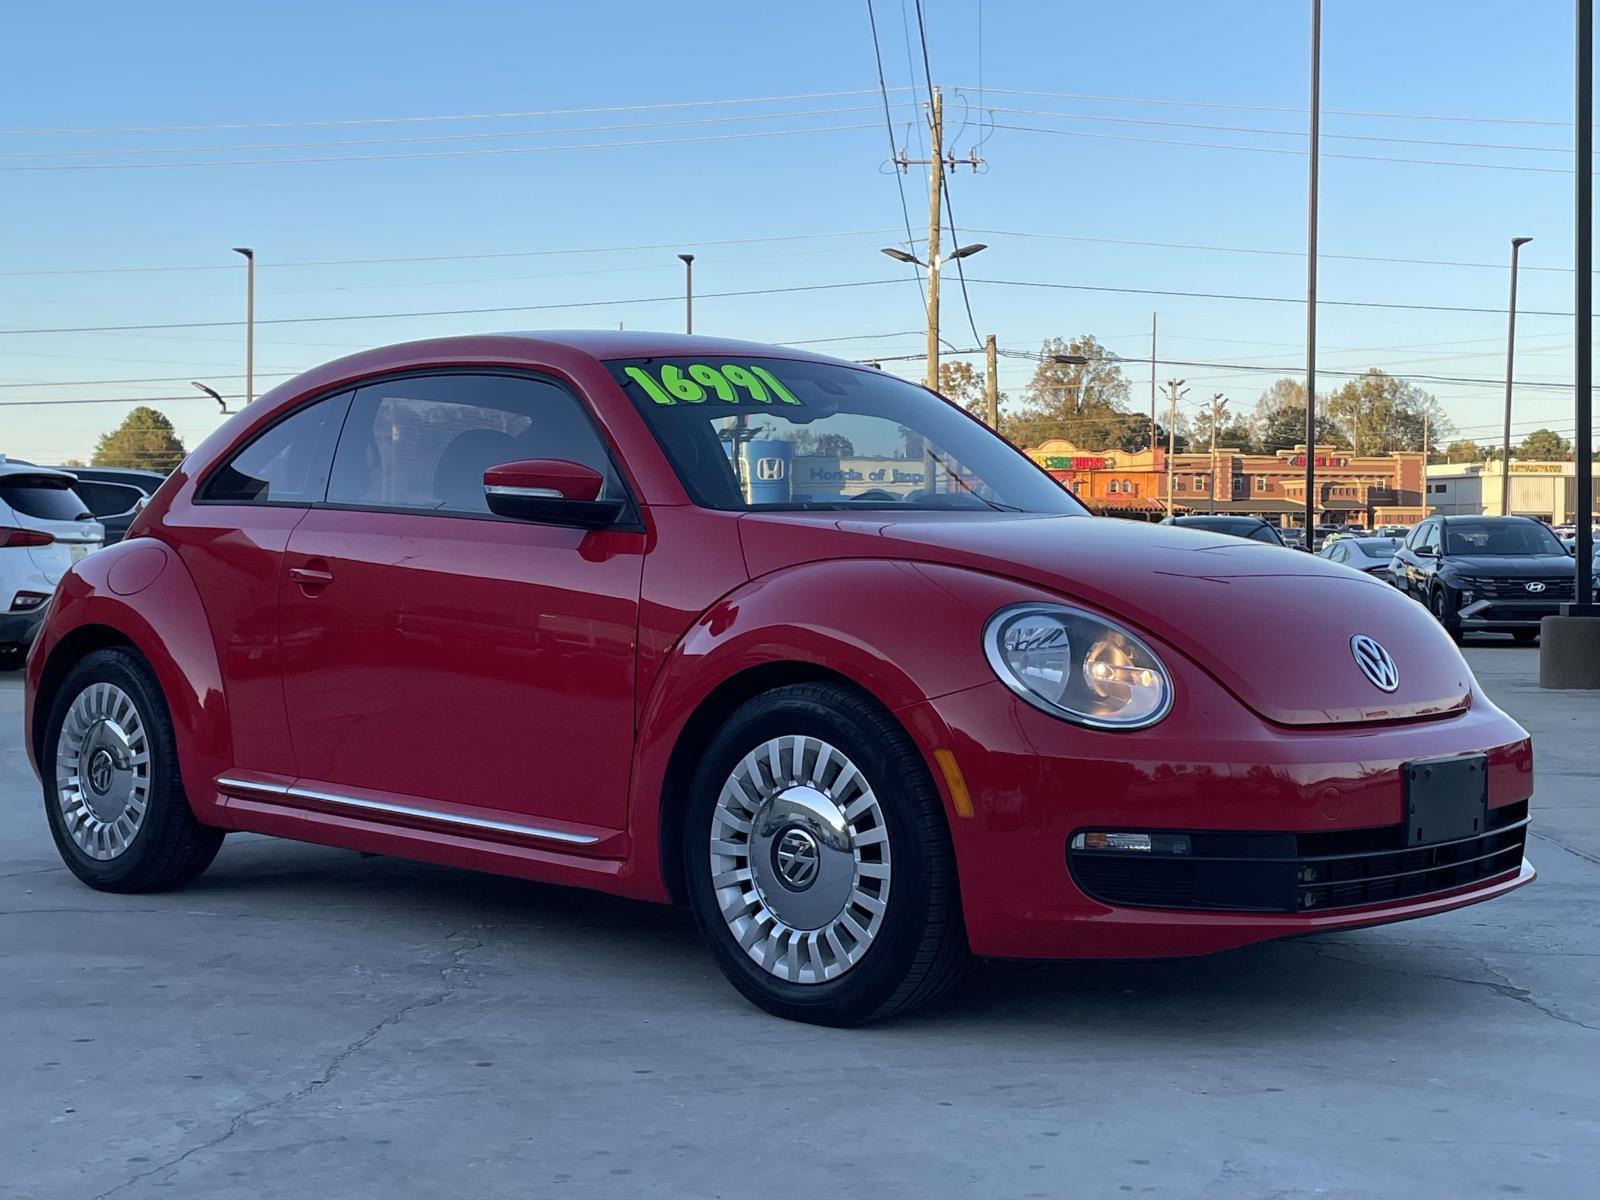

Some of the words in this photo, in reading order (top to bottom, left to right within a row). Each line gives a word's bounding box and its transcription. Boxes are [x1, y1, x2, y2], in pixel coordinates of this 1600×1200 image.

[624, 364, 802, 406] 16991
[810, 467, 864, 481] Honda
[868, 468, 886, 481] of
